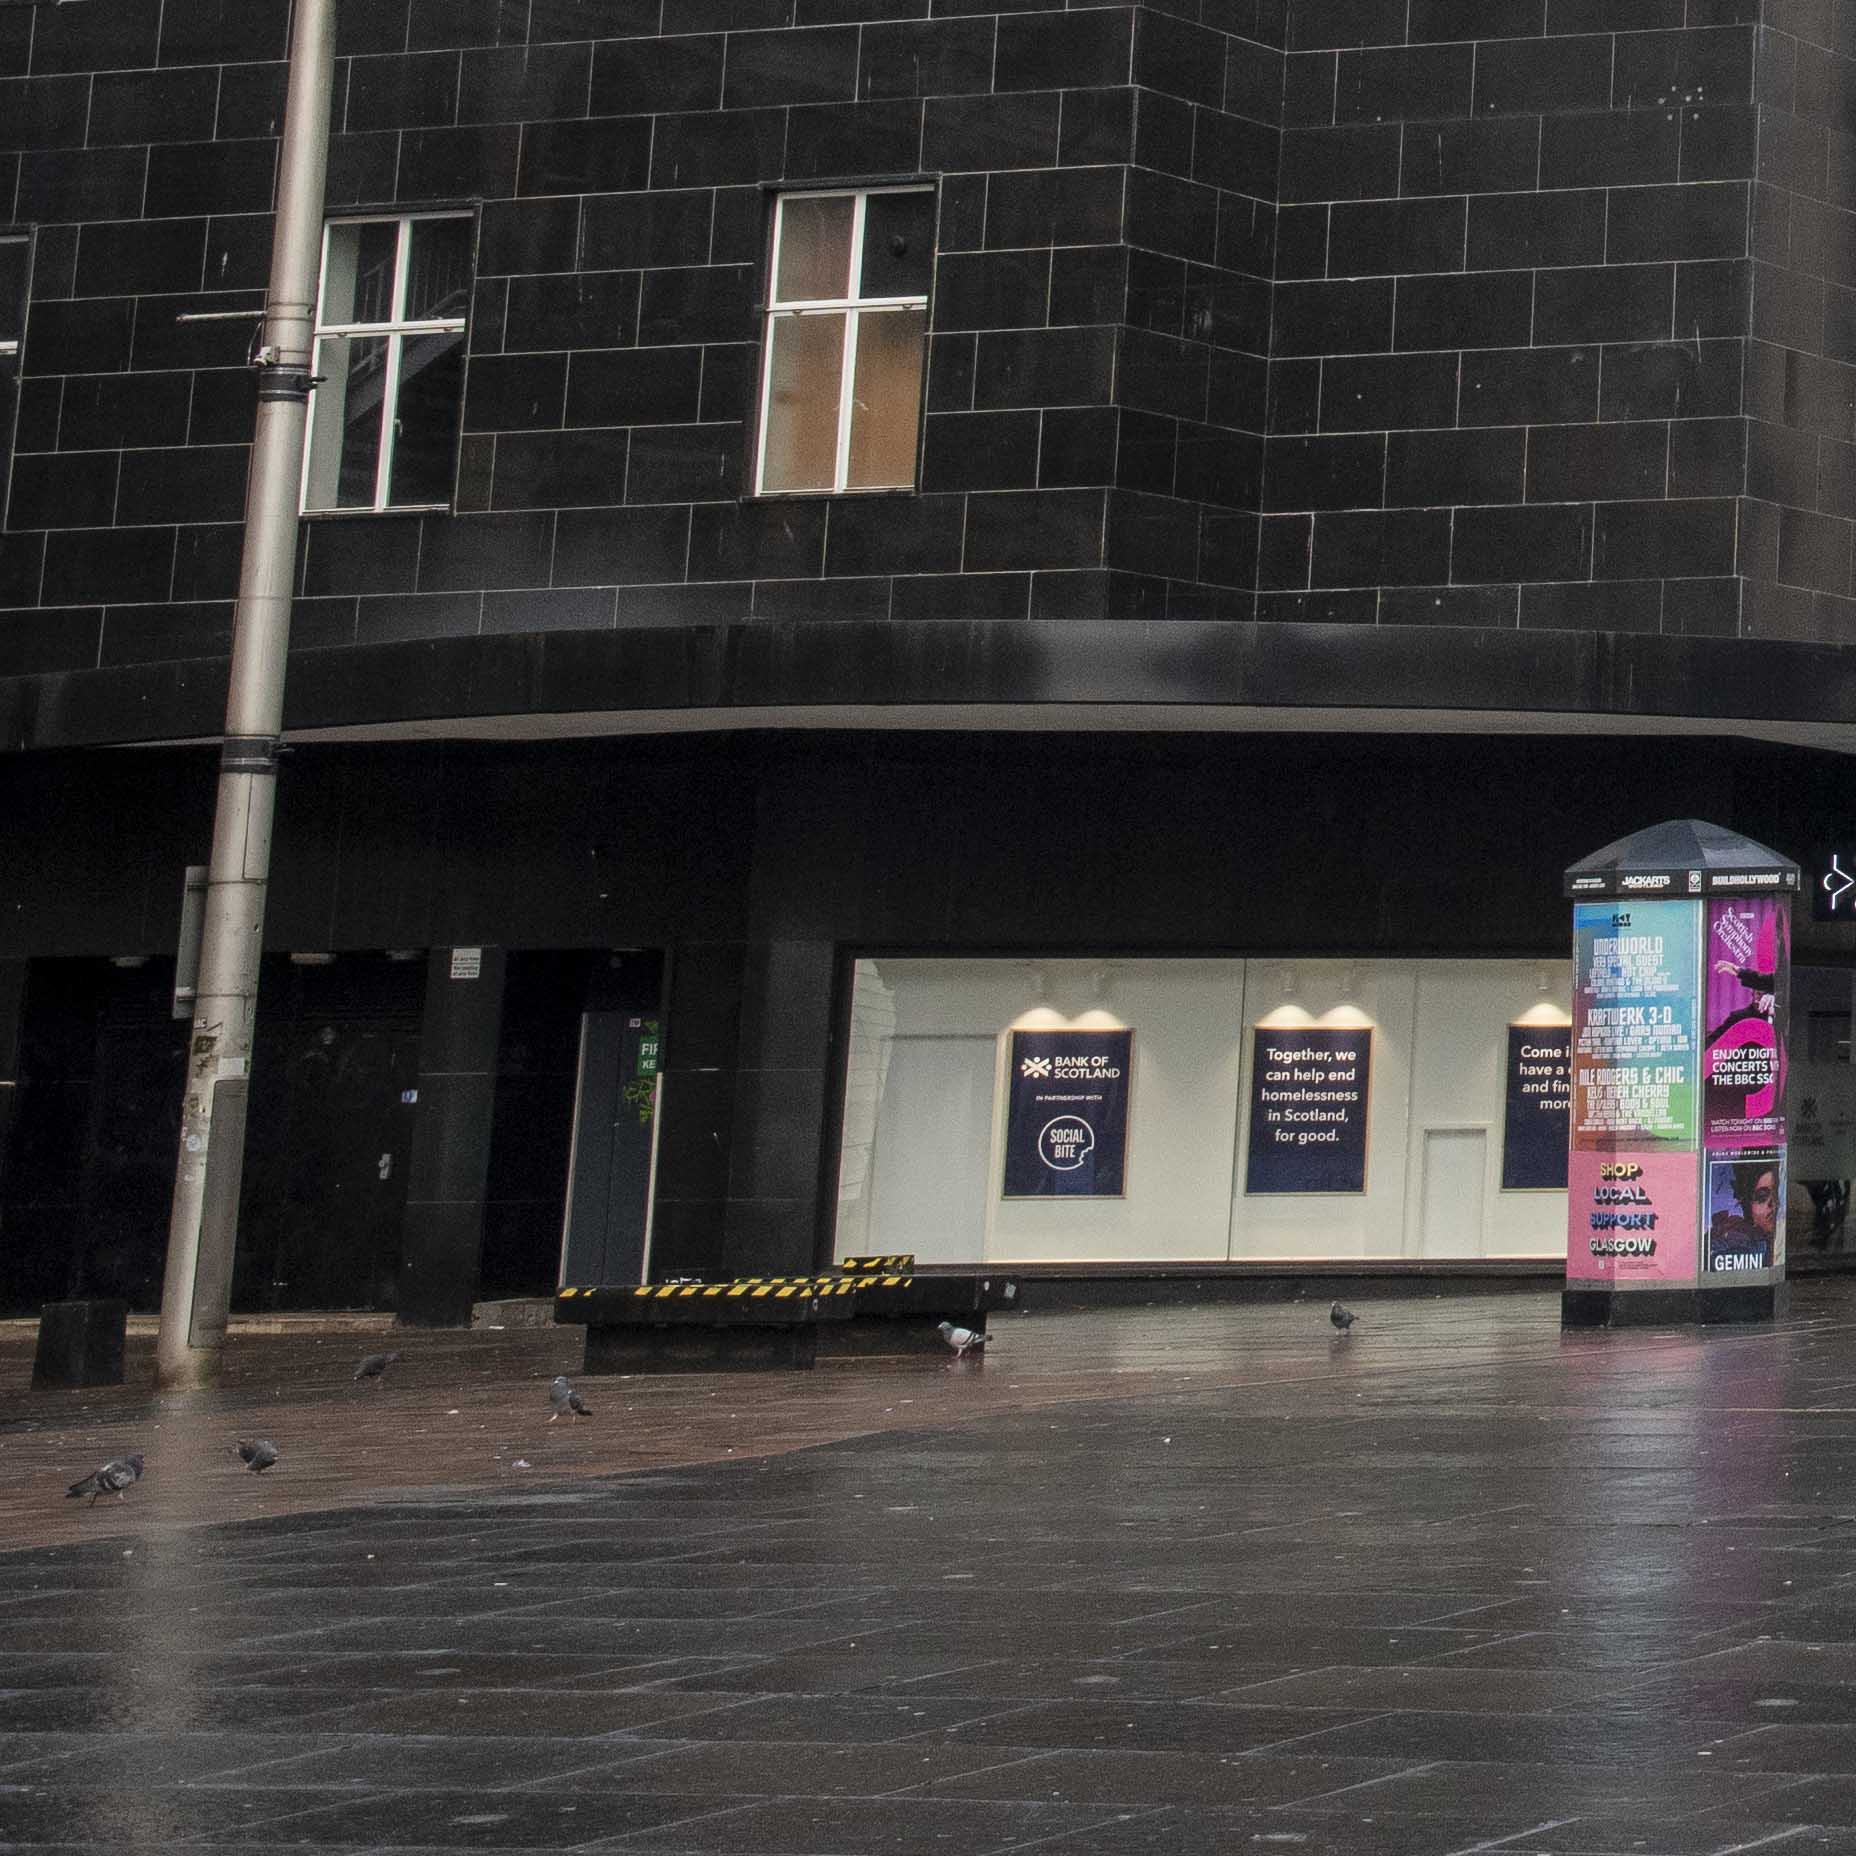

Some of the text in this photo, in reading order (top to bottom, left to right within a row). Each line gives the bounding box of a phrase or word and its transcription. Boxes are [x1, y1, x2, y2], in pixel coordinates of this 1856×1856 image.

[1621, 875, 1670, 885] JACKARTS
[1728, 906, 1753, 944] Scottish
[1713, 920, 1746, 964] Orchestra
[1721, 914, 1752, 957] Symphony
[1587, 1006, 1672, 1027] KRAFTWERK 3-D
[1266, 1048, 1357, 1064] Together, we
[1521, 1045, 1561, 1058] Come
[1566, 1045, 1571, 1058] i
[1712, 1048, 1747, 1060] ENJOY
[642, 1060, 656, 1069] KE
[1054, 1056, 1109, 1066] BANK OF
[1519, 1062, 1552, 1075] have
[1556, 1066, 1564, 1075] a
[1712, 1061, 1768, 1073] CONCERTS
[1054, 1068, 1121, 1079] SCOTLAND
[1265, 1067, 1356, 1084] can help end
[1655, 1065, 1685, 1083] CHIC
[1712, 1074, 1734, 1086] THE
[1735, 1074, 1755, 1085] BBC
[1522, 1079, 1570, 1093] and fin
[1632, 1084, 1670, 1098] CHERRY
[1262, 1087, 1359, 1101] homelessness
[1268, 1108, 1349, 1123] in Scotland,
[1050, 1129, 1085, 1144] SOCIAL
[1275, 1128, 1340, 1145] for good.
[1054, 1145, 1076, 1159] BITE
[1600, 1163, 1640, 1178] SHOP
[1593, 1186, 1650, 1202] LOCAL
[1590, 1212, 1656, 1227] SUPPORT
[1589, 1238, 1654, 1254] GLASGOW
[1714, 1253, 1763, 1271] GEMINI
